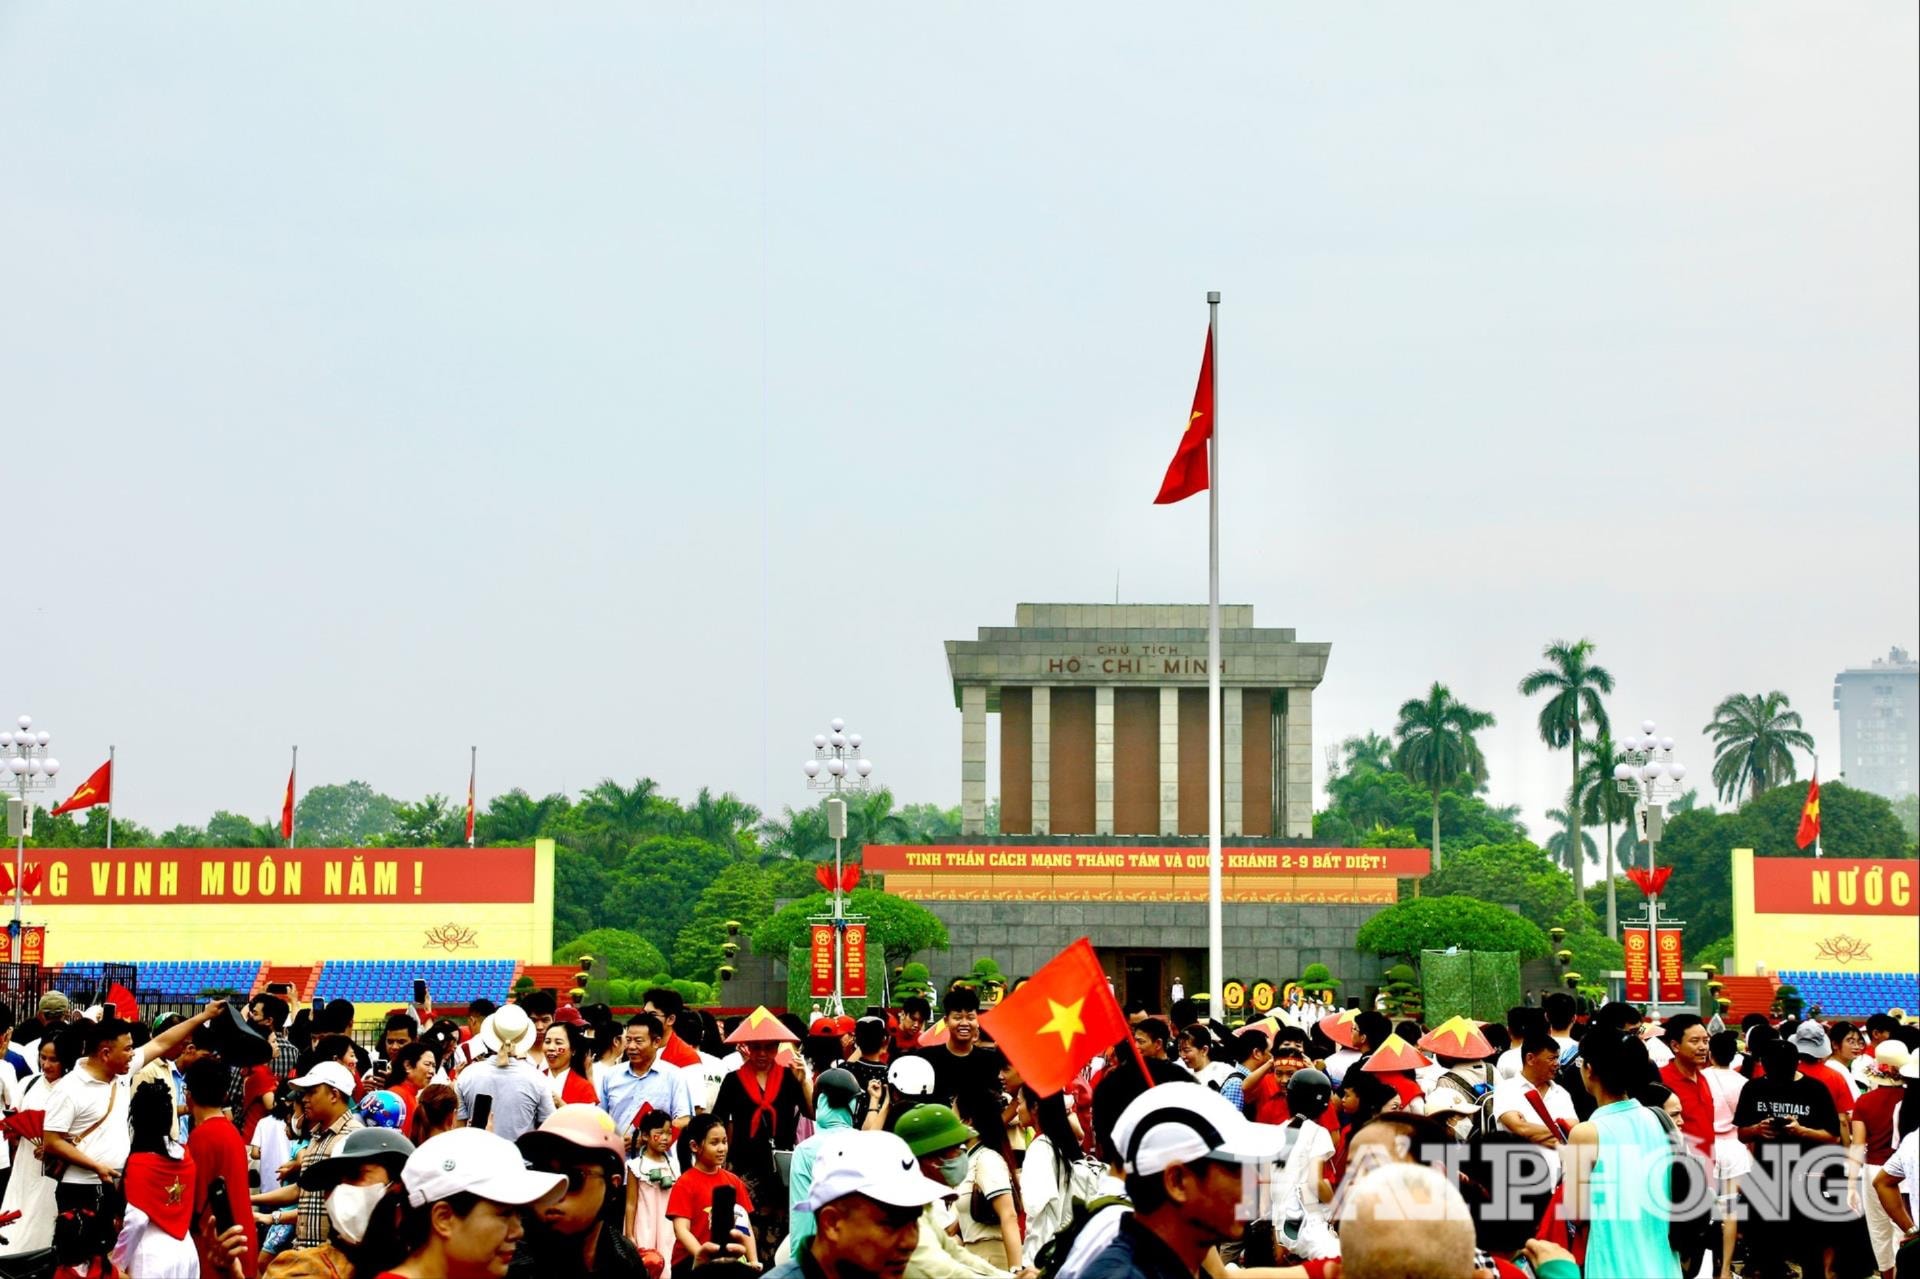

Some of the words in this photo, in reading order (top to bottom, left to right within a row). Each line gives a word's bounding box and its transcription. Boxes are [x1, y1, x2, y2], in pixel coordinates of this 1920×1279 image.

[90, 861, 178, 896] VINH
[201, 855, 302, 896] MUÔN
[905, 853, 941, 866] TINH
[989, 850, 1027, 866] CÁCH
[1031, 853, 1072, 869] MẠNG
[1076, 852, 1124, 867] THÁNG
[1129, 852, 1160, 868] TÁM
[1163, 851, 1183, 868] VÀ
[1228, 852, 1278, 868] KHÁNH
[1282, 855, 1308, 868] 2-9
[1312, 851, 1342, 869] BẤT
[1811, 865, 1910, 907] NƯỚC
